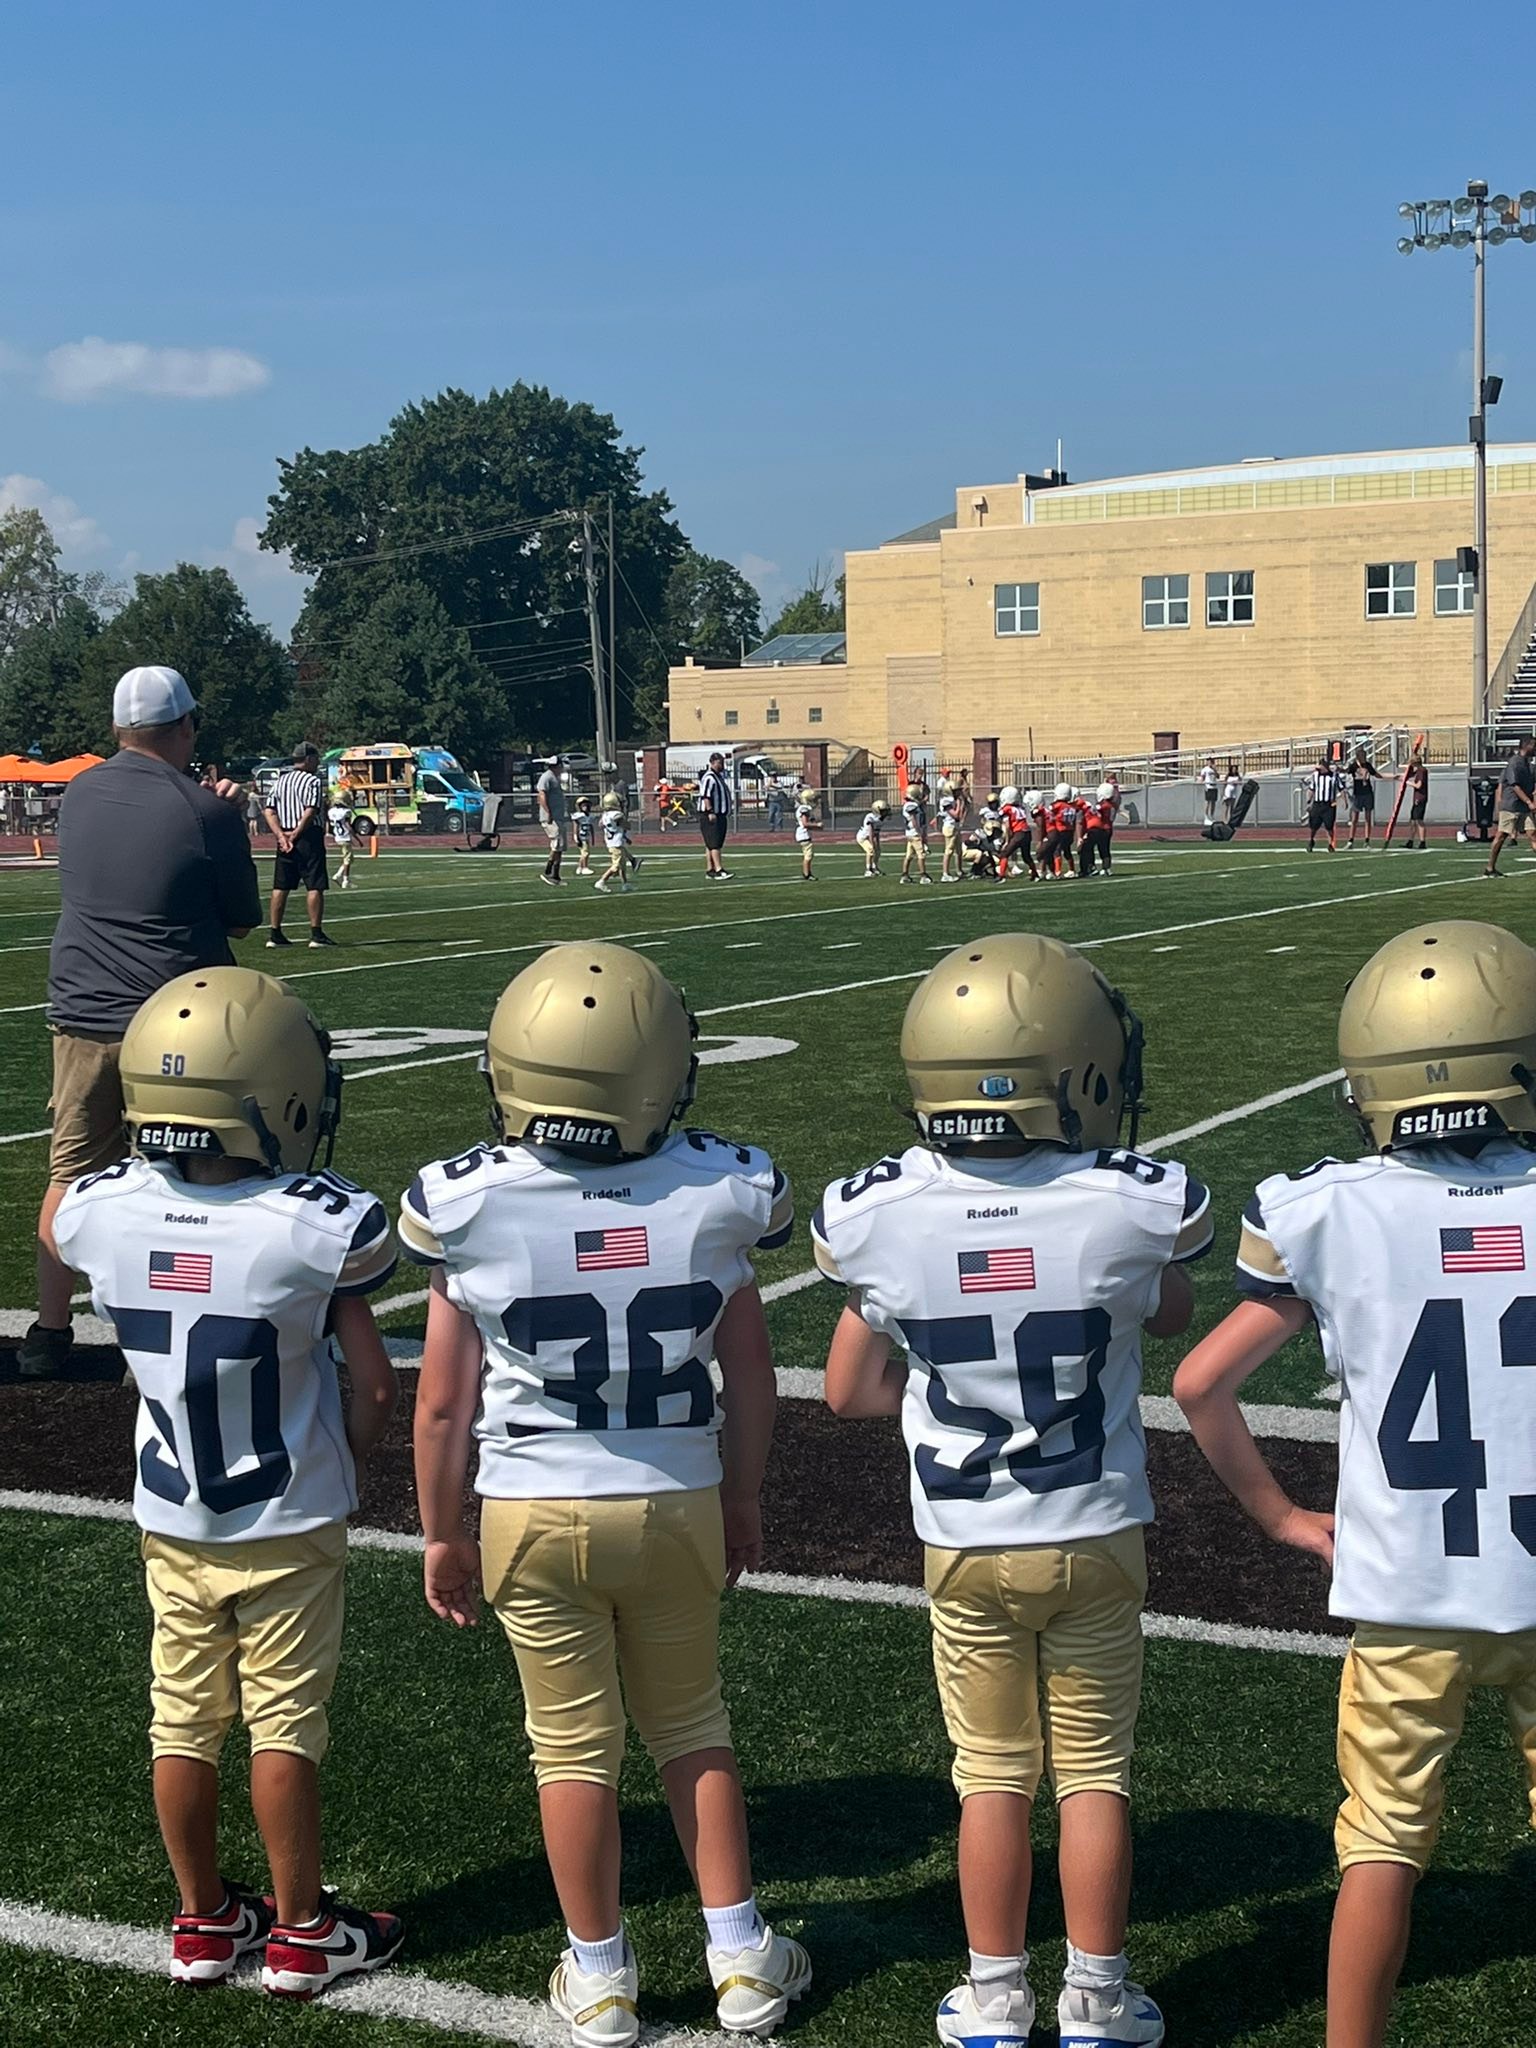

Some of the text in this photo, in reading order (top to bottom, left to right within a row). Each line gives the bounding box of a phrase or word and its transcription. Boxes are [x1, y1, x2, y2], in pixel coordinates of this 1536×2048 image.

[162, 1054, 185, 1077] 50
[1425, 1061, 1449, 1084] M
[932, 1111, 1006, 1135] schutt
[1400, 1105, 1489, 1136] schutt
[141, 1124, 211, 1149] schutt
[532, 1119, 613, 1146] schutt
[582, 1187, 631, 1200] Riddell
[1448, 1185, 1504, 1197] Riddell
[164, 1212, 209, 1225] Riddell
[966, 1205, 1019, 1220] Riddell
[500, 1280, 724, 1438] 36
[103, 1303, 293, 1515] 50
